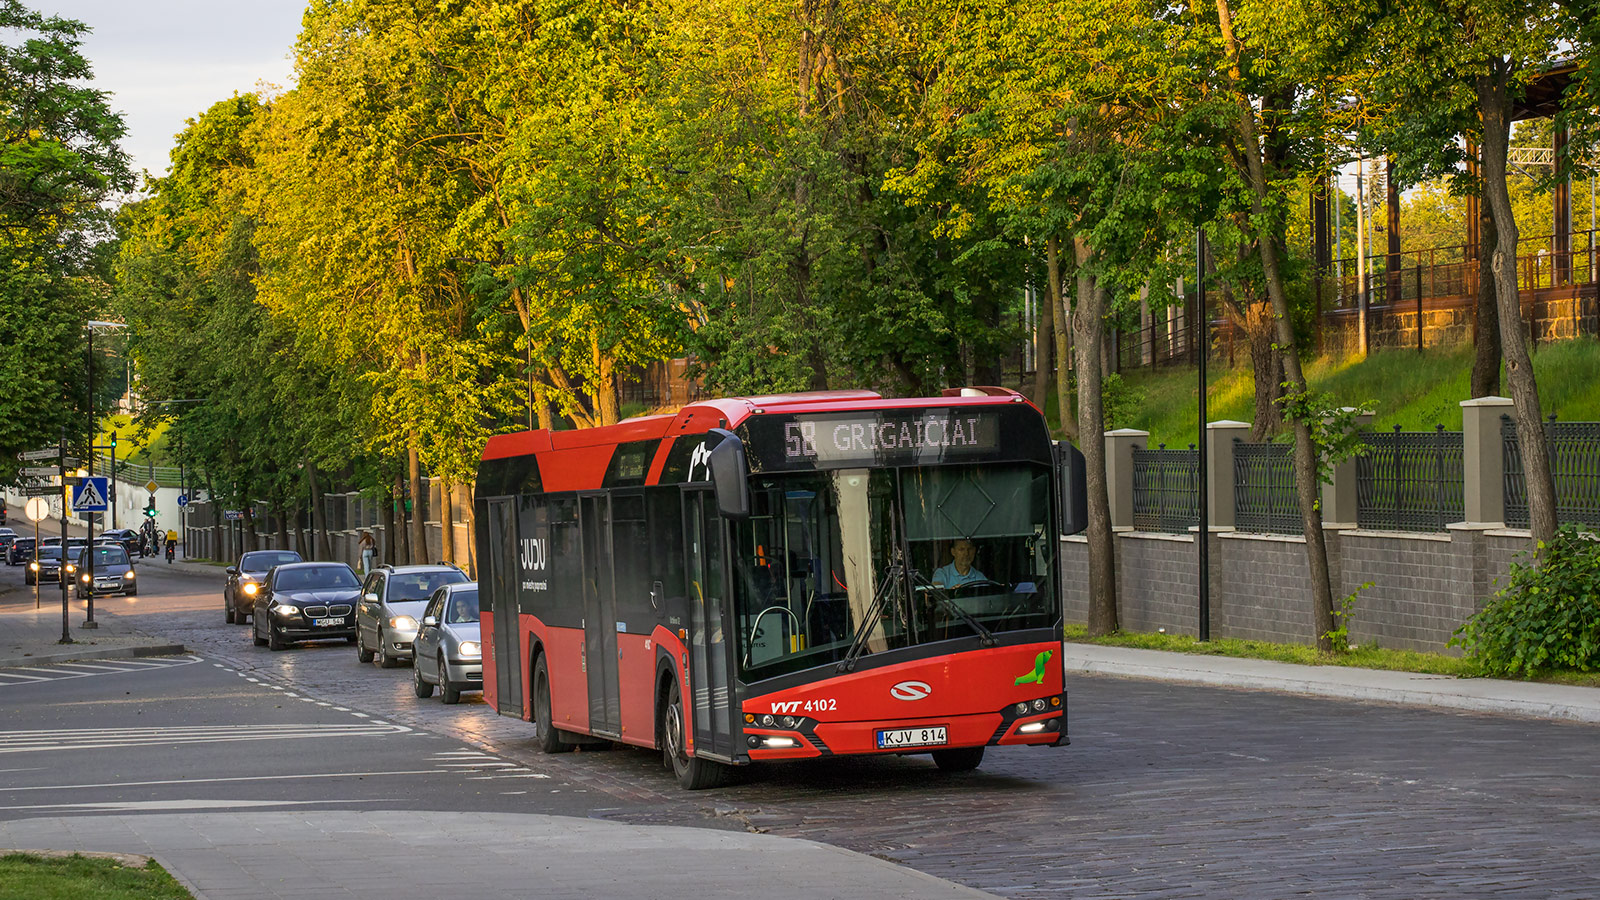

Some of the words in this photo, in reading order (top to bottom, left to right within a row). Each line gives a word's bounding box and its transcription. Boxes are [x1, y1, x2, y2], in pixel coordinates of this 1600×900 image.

[832, 414, 977, 450] GRIGAIČIAI
[520, 538, 546, 570] JUDU
[803, 698, 837, 712] 4102
[885, 730, 912, 744] KJV
[921, 728, 944, 742] 814
